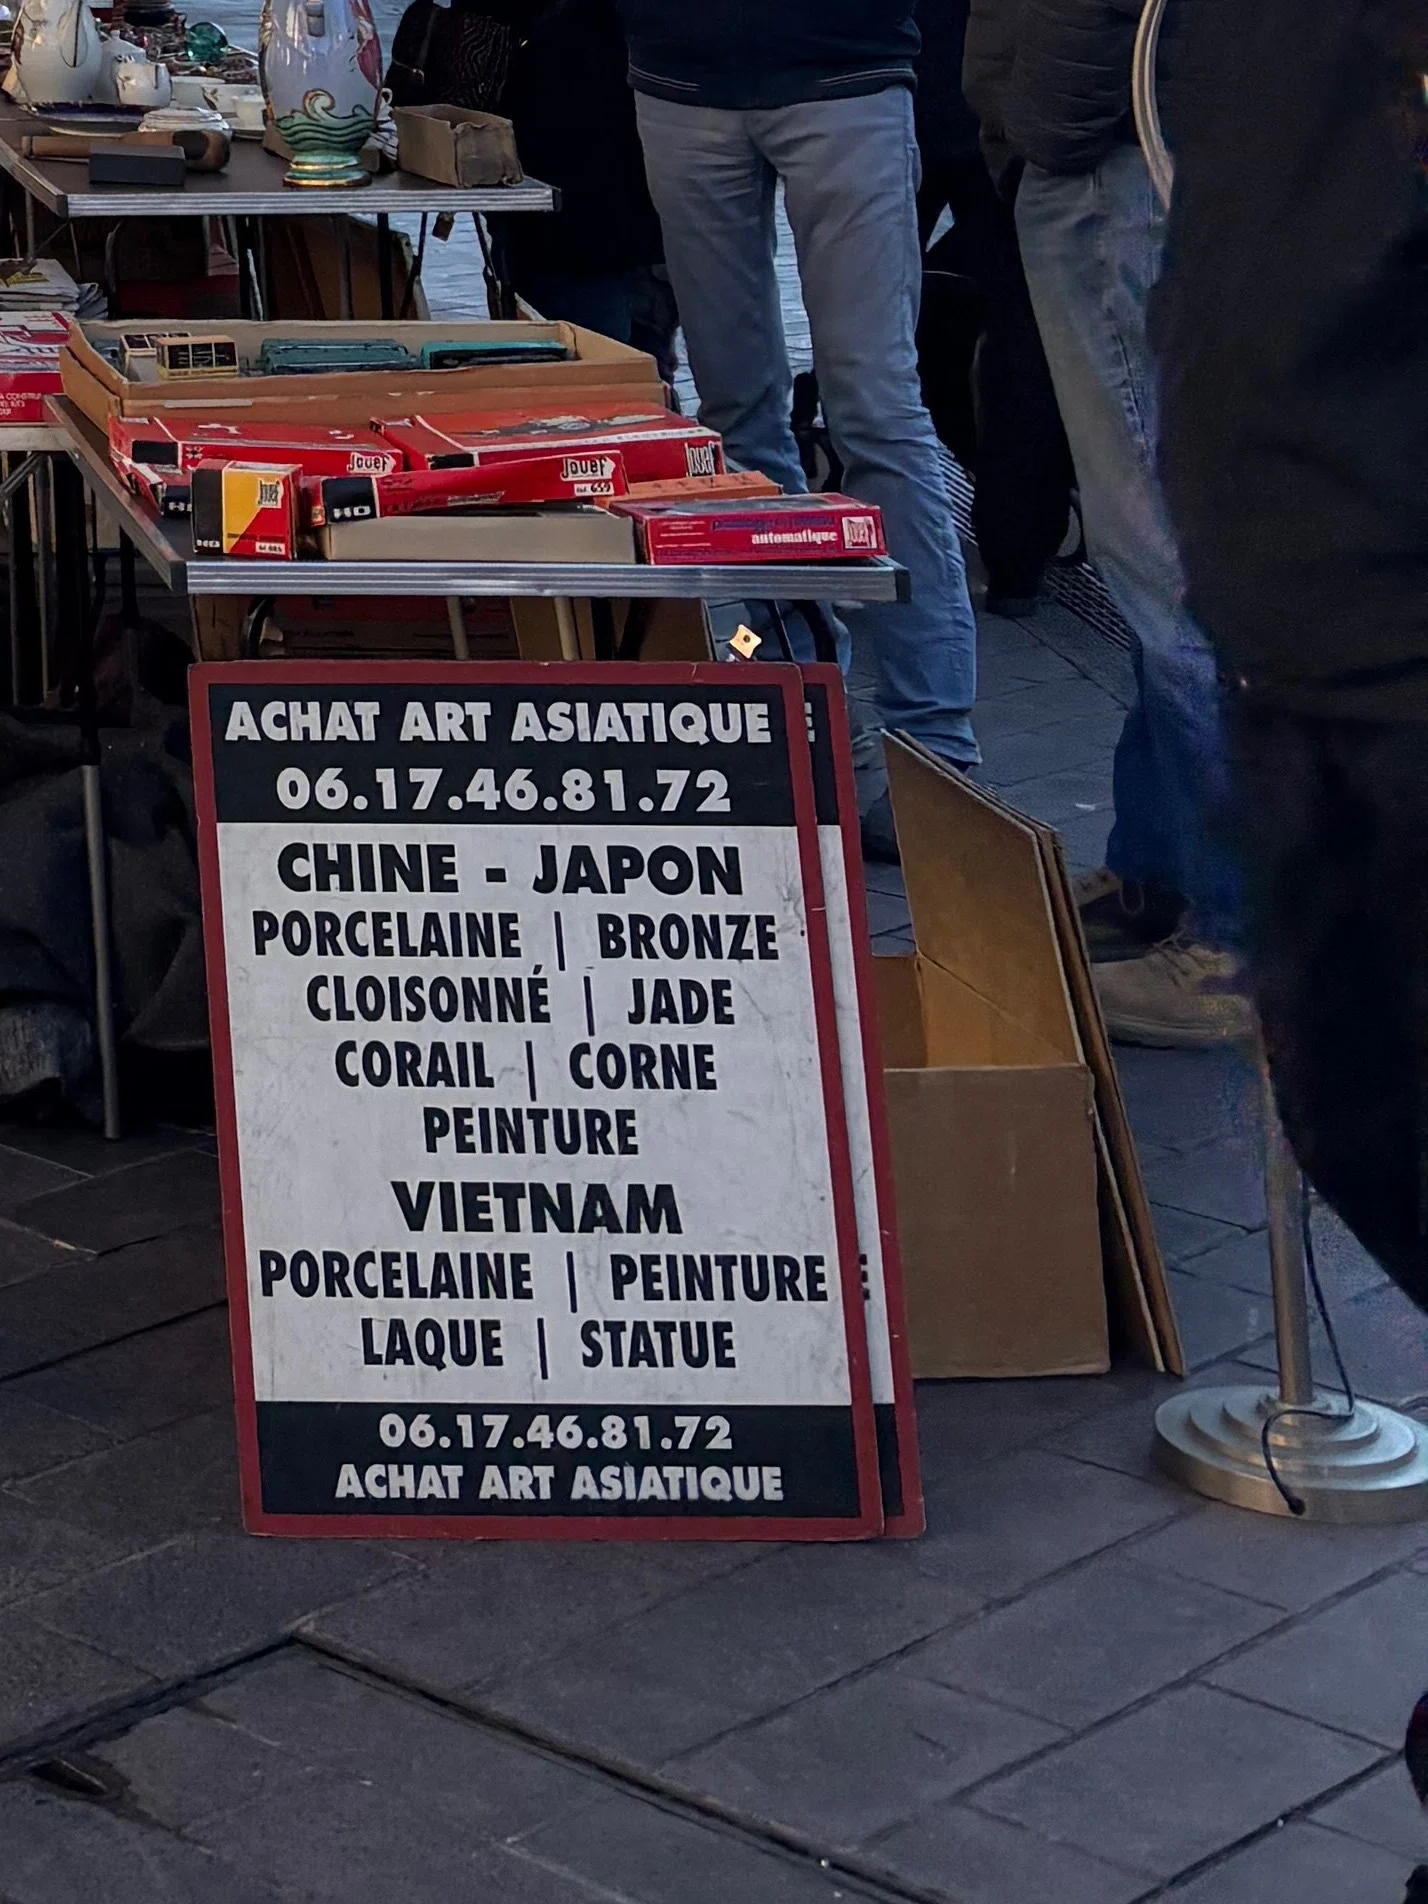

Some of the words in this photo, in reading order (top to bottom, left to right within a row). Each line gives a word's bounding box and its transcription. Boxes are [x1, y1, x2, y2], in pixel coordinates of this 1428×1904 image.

[334, 504, 372, 518] HO
[751, 528, 838, 545] automatique
[225, 701, 379, 741] ACHAT
[400, 702, 491, 741] ART
[511, 702, 771, 745] ASIATIQUE
[277, 768, 730, 811] 06.17.46.81.72
[278, 843, 458, 892] CHINE
[533, 845, 742, 895] JAPON
[253, 911, 521, 957] PORCELAINE
[598, 914, 778, 961] BRONZE
[307, 965, 550, 1023] CLOISONNÉ
[628, 979, 734, 1024] JADE
[335, 1041, 494, 1088] CORAIL
[570, 1043, 717, 1090] CORNE
[424, 1107, 638, 1155] PEINTURE
[391, 1181, 682, 1234] VIETNAM
[260, 1250, 533, 1299] PORCELAINE
[610, 1254, 828, 1301] PEINTURE
[362, 1318, 503, 1371] LAQUE
[581, 1320, 736, 1368] STATUE
[380, 1414, 732, 1449] 06.17.46.81.72
[336, 1464, 463, 1498] ACHAT
[479, 1466, 554, 1499] ART
[571, 1466, 783, 1501] ASIATIQUE
